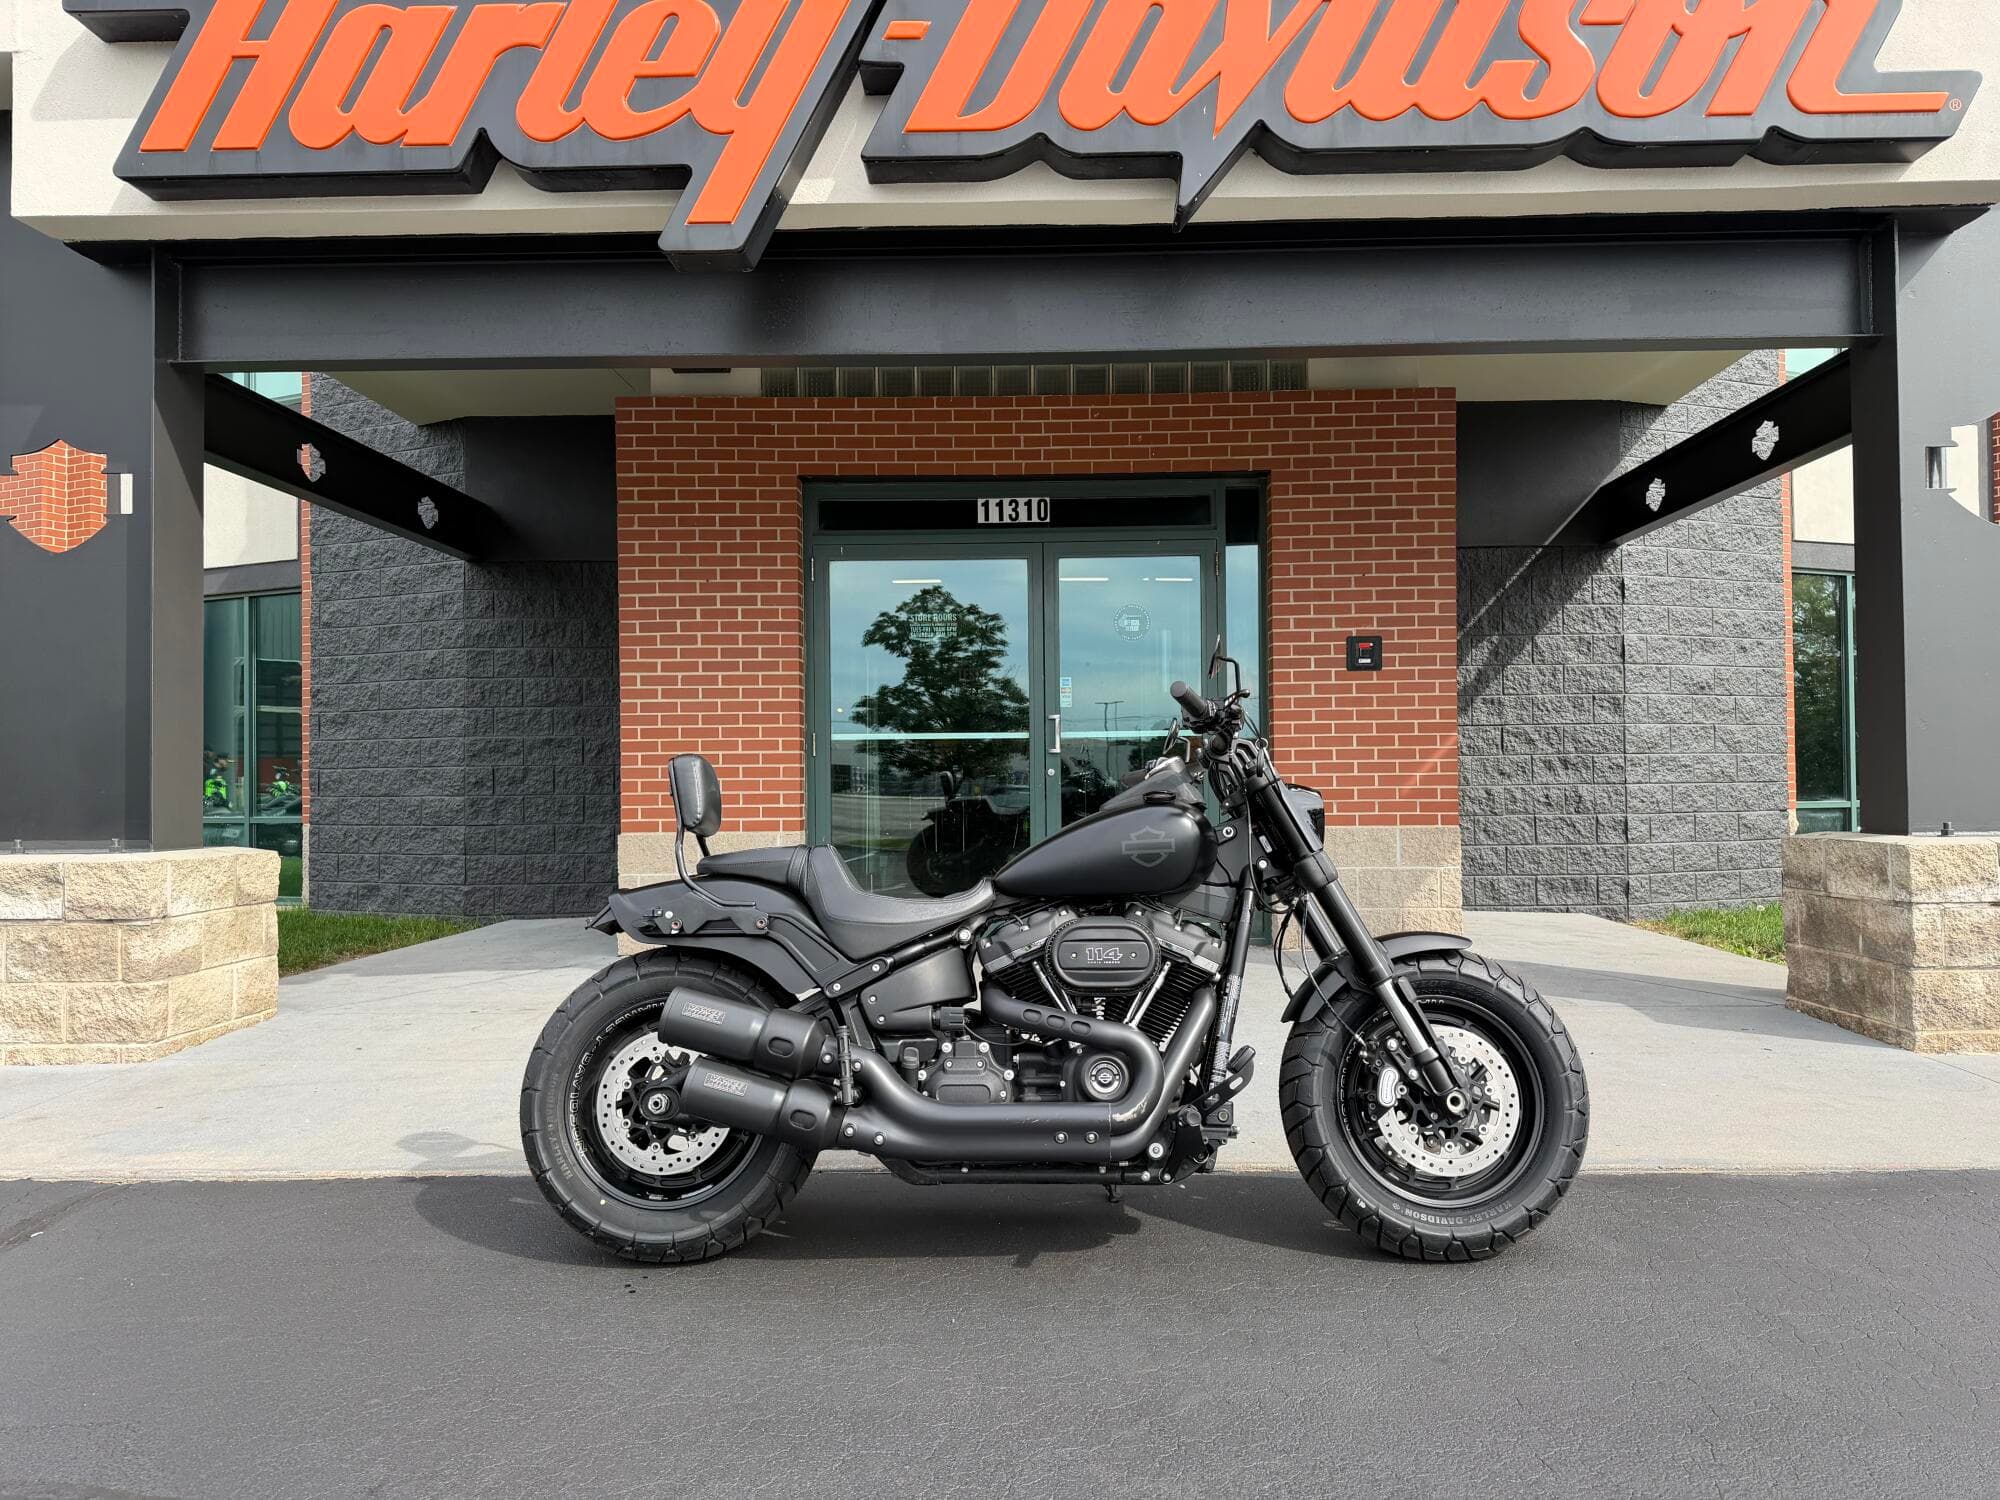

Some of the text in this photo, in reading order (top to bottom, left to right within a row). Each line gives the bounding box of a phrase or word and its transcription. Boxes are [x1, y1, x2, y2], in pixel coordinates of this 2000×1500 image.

[981, 499, 1048, 522] 11310
[1086, 947, 1123, 961] 114
[1404, 1202, 1512, 1225] HARLEY-DAVIDSON
